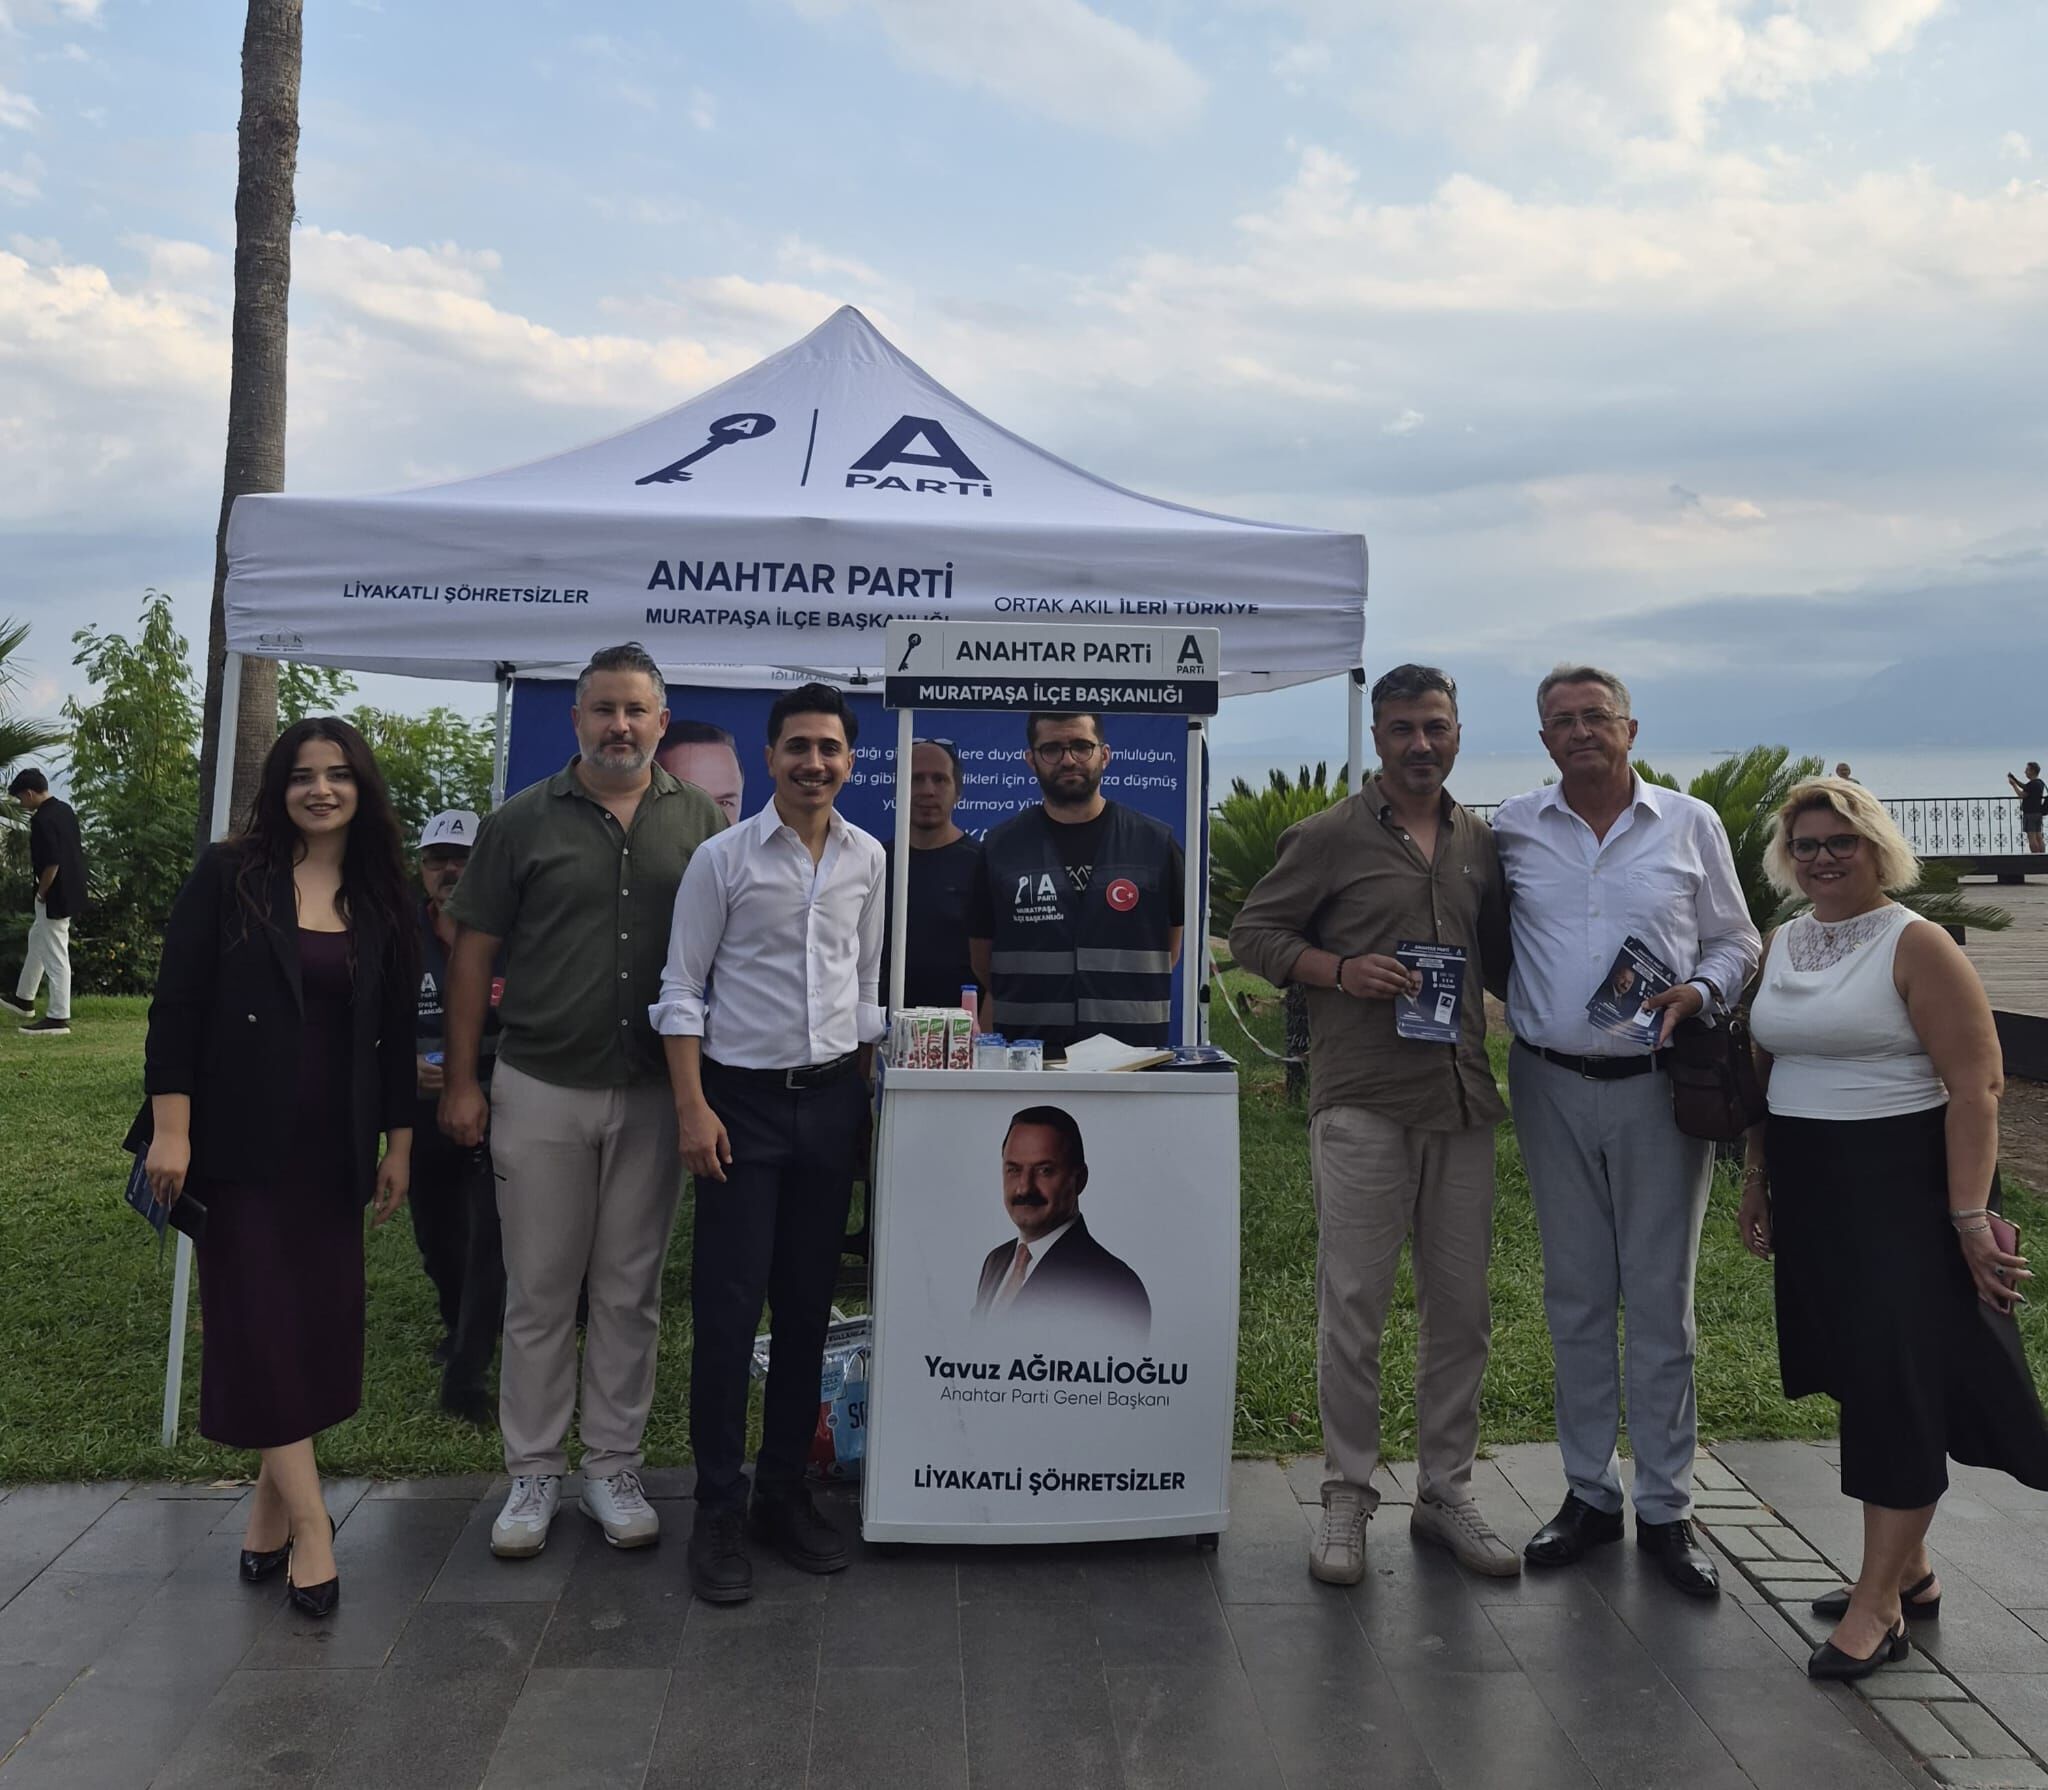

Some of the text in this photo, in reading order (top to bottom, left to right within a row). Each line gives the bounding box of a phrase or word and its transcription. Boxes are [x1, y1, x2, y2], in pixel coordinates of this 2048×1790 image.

[848, 414, 991, 481] A
[647, 559, 953, 599] ANAHTAR PARTİ
[444, 584, 589, 605] ŞÖHRETSİZLER
[994, 596, 1064, 613] ORTAK
[1069, 598, 1114, 615] AKIL
[645, 607, 770, 629] MURATPAŞA
[776, 606, 821, 630] İLÇE
[955, 640, 1076, 663] ANAHTAR
[1177, 634, 1204, 664] A
[919, 682, 1183, 707] MURATPAŞA İLÇE BAŞKANLIĞI
[1111, 748, 1176, 763] mluluğun,
[1002, 772, 1025, 788] için
[1123, 773, 1178, 791] düşmüş
[1037, 873, 1057, 895] A
[924, 1353, 1189, 1385] Yavuz AĞIRALİOĞLU
[940, 1386, 1170, 1410] Anahtar Parti Genel Başkanı
[914, 1464, 1187, 1496] LİYAKATLİ ŞÖHRETSİZLER
